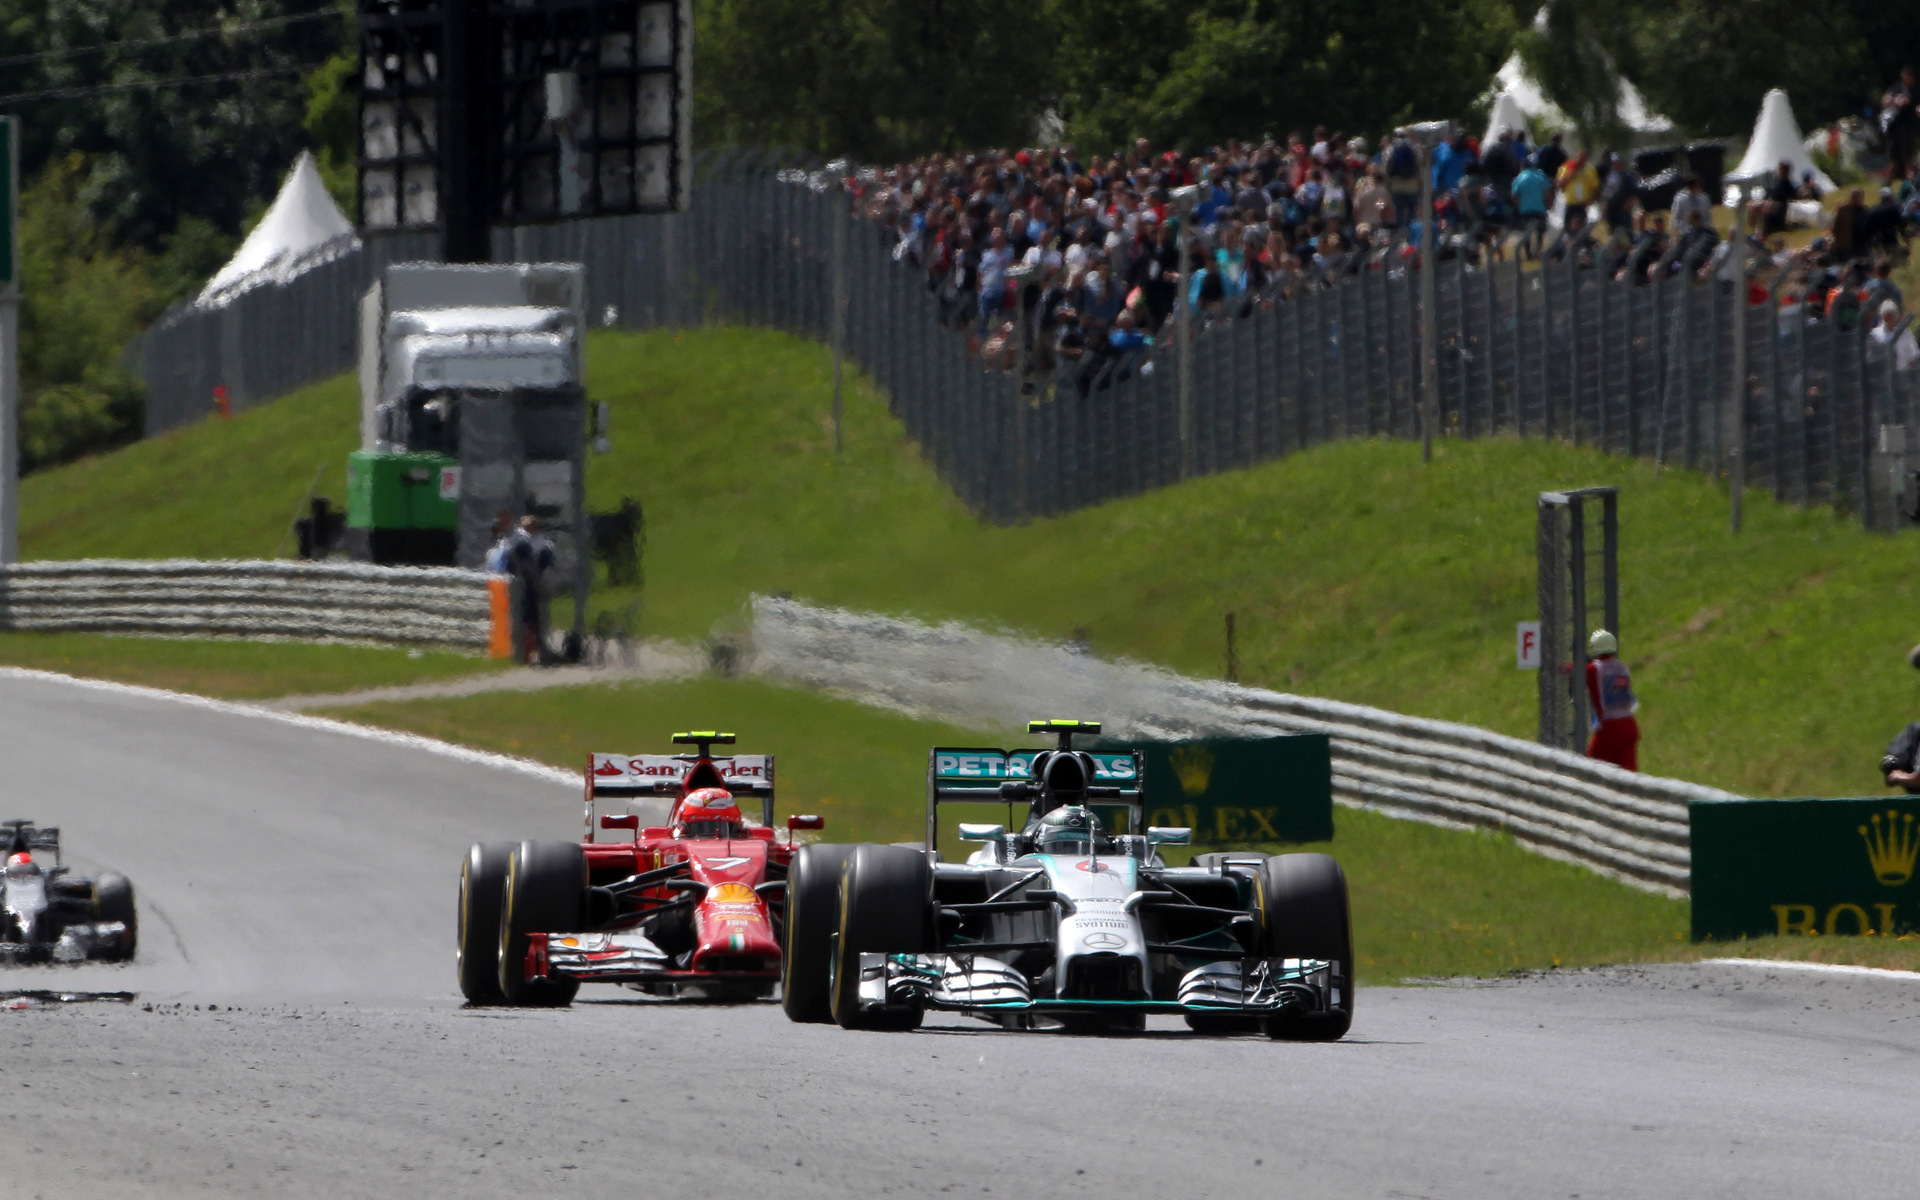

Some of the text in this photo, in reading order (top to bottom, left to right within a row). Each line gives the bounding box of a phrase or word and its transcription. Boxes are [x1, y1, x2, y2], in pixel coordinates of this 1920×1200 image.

[1522, 630, 1536, 661] F
[629, 759, 763, 777] Sander
[936, 755, 1134, 778] PETRAS
[705, 857, 752, 870] 7
[1770, 903, 1920, 937] ROL
